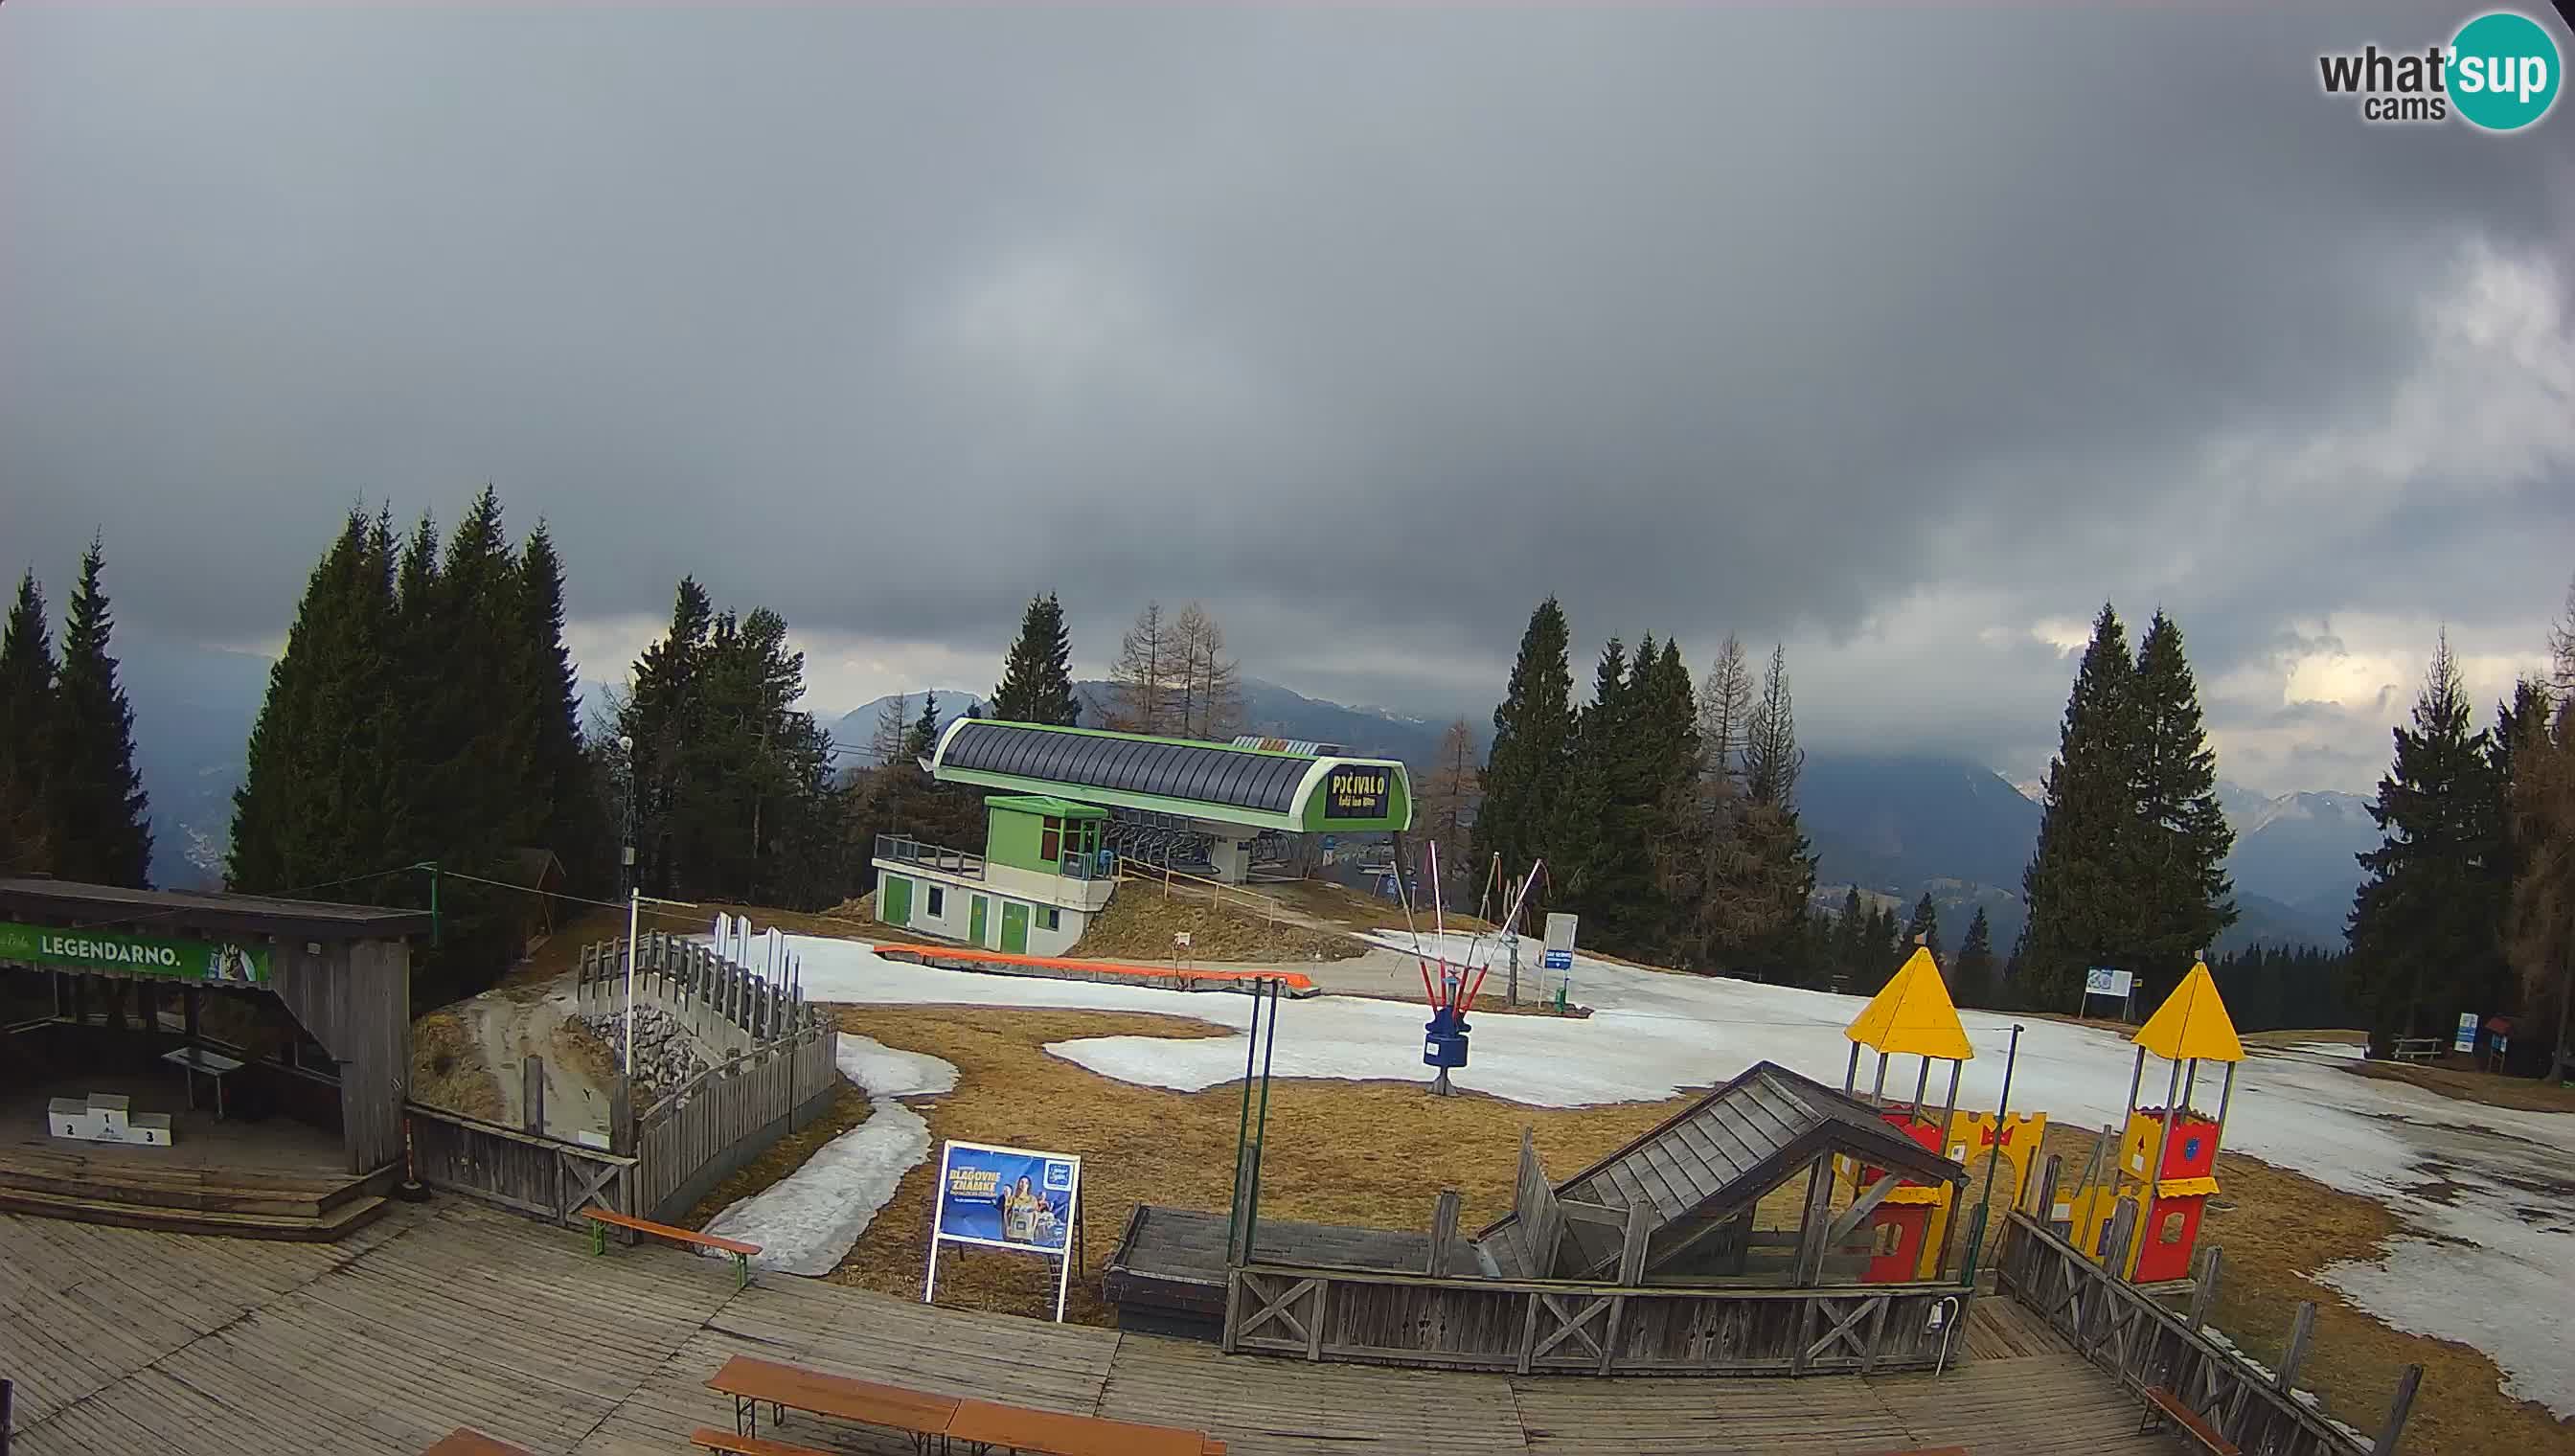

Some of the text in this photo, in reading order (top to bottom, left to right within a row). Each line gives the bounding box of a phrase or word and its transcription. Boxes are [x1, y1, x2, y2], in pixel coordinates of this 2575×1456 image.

[42, 936, 181, 967] LEGENDARNO.
[103, 1113, 110, 1124] 1
[66, 1125, 74, 1135] 2
[146, 1131, 154, 1142] 3
